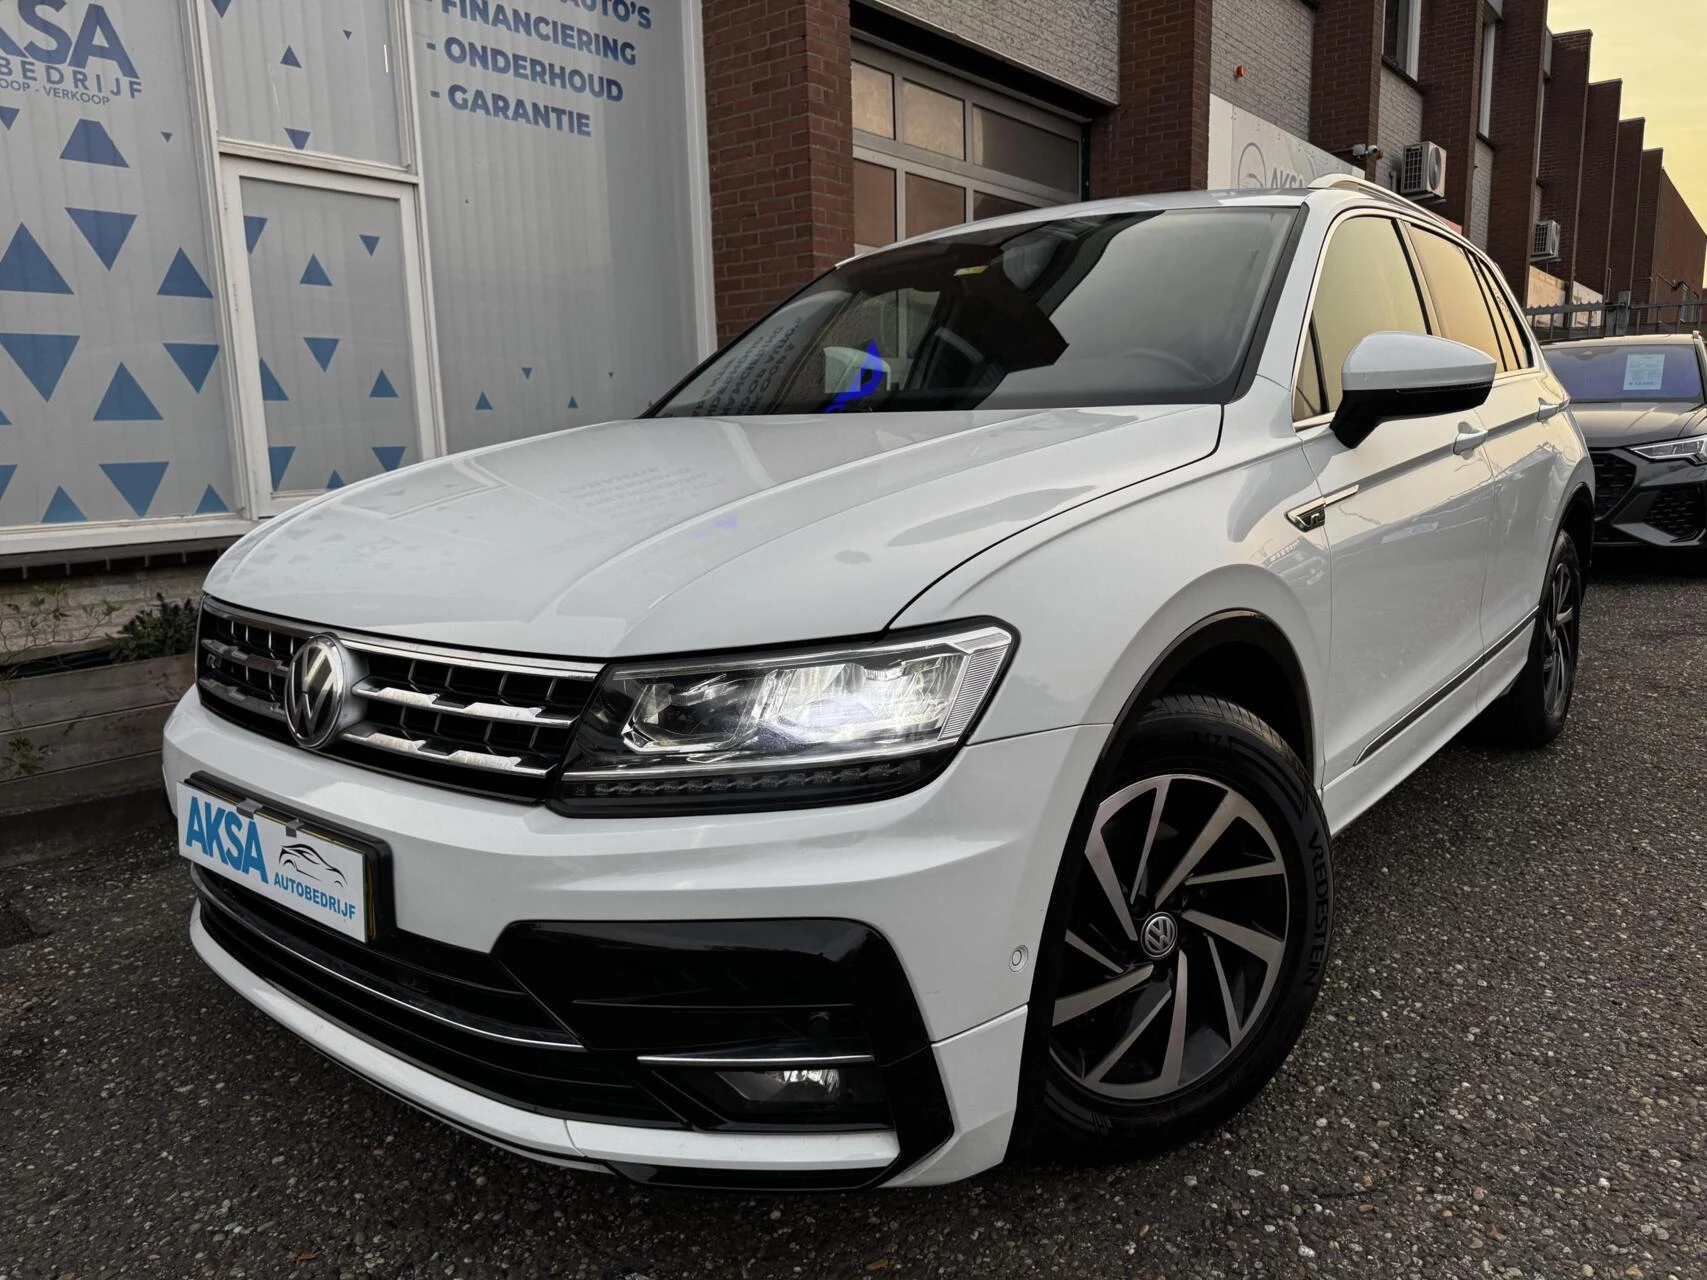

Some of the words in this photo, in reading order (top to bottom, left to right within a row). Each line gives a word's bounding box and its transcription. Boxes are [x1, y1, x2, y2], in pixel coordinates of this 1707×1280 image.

[0, 0, 140, 79] SA
[441, 0, 637, 65] FINANCIERING
[42, 85, 110, 106] VERKOOP
[444, 36, 624, 102] ONDERHOUD
[447, 83, 591, 138] GARANTIE
[186, 795, 269, 885] AKSA
[273, 872, 356, 920] AUTOBEDRIJF
[1304, 828, 1329, 986] VREDESTEIN
